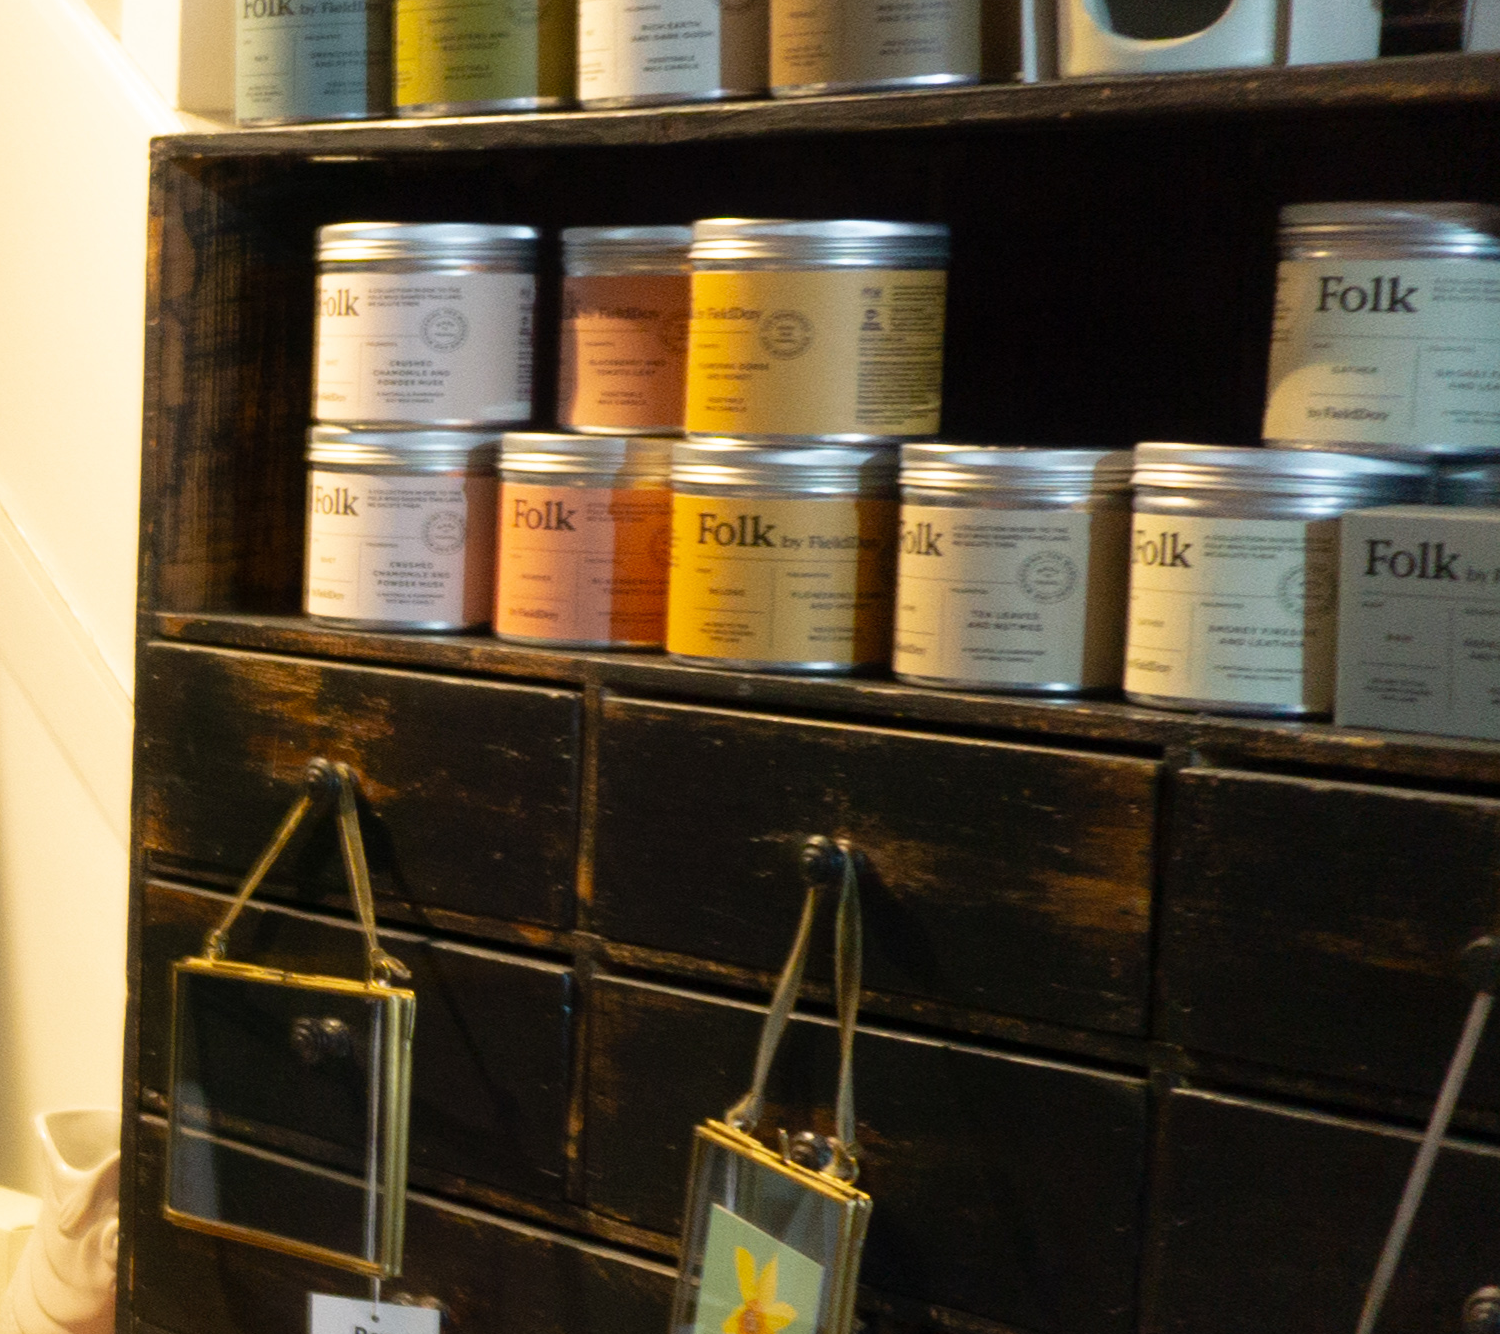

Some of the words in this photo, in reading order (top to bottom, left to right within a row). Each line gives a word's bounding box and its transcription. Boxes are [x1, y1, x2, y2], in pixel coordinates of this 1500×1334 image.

[1316, 275, 1420, 313] Folk
[314, 485, 359, 518] Folk
[512, 499, 576, 532] Folk
[698, 513, 776, 548] Folk
[1364, 539, 1462, 581] Folk
